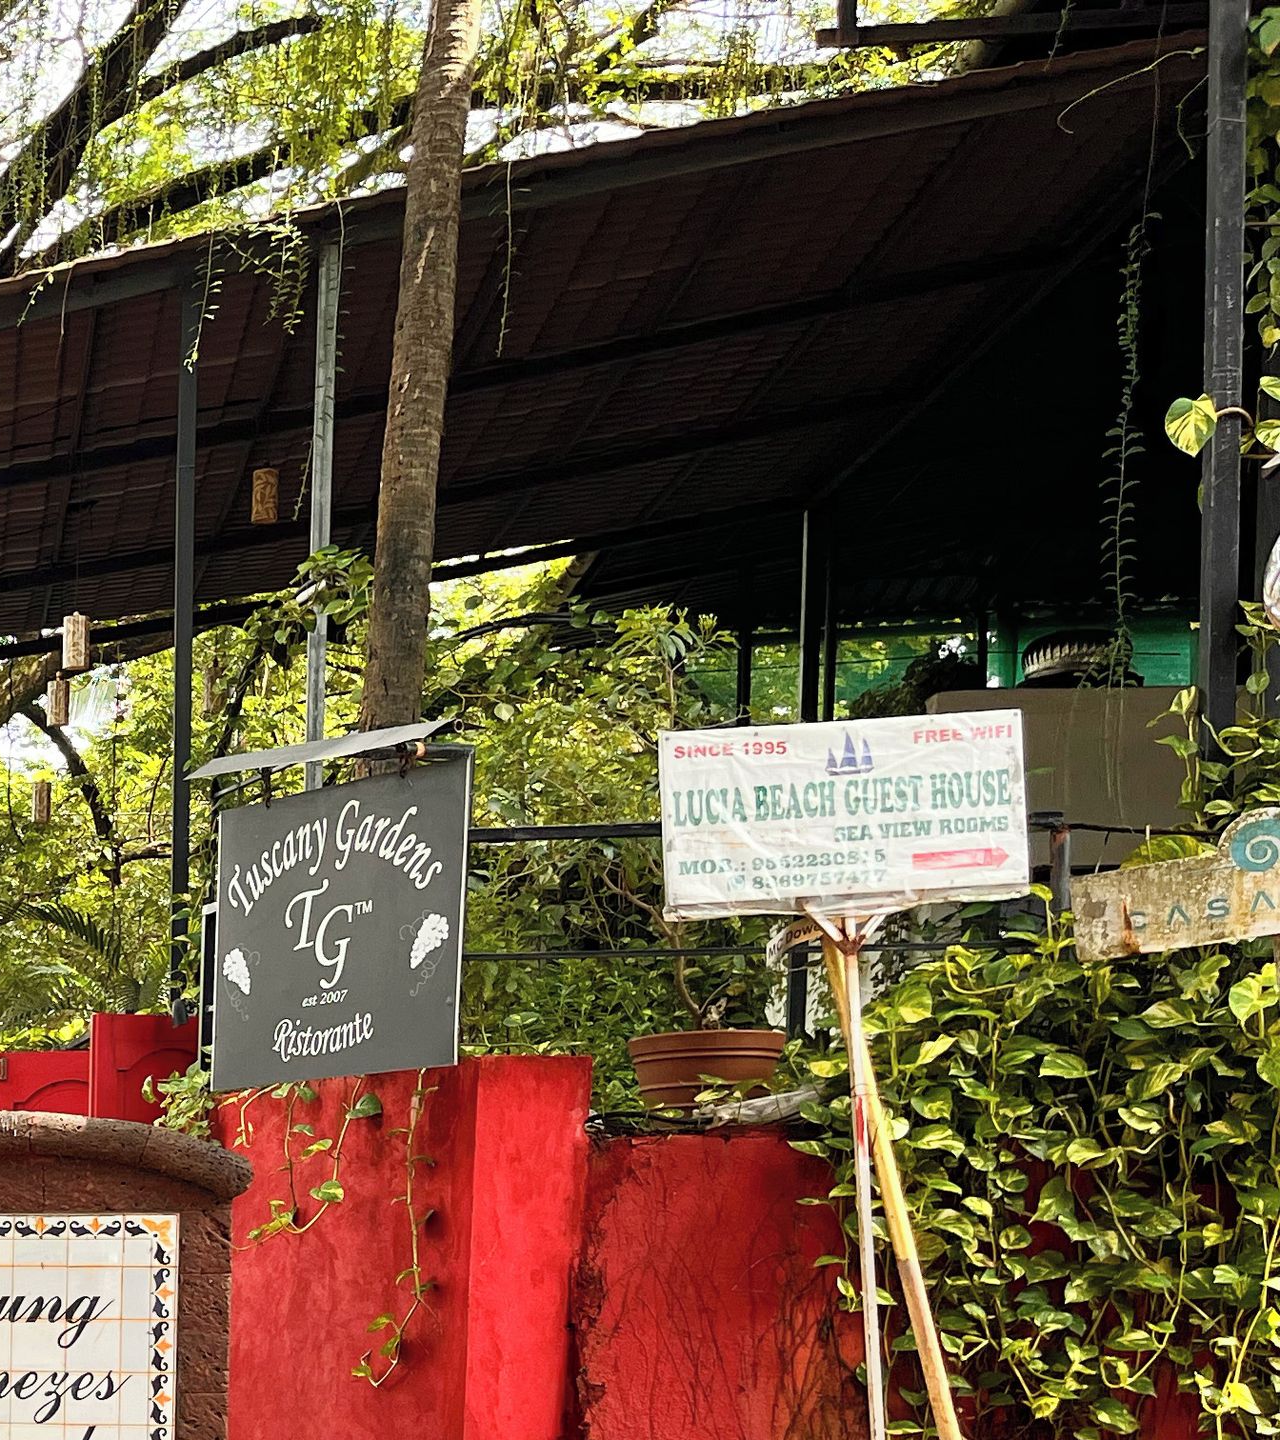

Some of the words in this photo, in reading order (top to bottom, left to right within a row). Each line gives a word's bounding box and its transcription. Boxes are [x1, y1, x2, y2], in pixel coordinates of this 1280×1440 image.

[913, 729, 964, 744] FREE
[970, 724, 1012, 740] WIFI
[674, 744, 734, 759] SINCE
[743, 741, 787, 756] 1995
[672, 786, 748, 827] LUCIA
[753, 780, 836, 822] BEACH
[844, 775, 923, 816] GUEST
[930, 768, 1012, 810] HOUSE
[833, 825, 873, 842] SEA
[878, 819, 932, 840] VIEW
[939, 815, 1009, 836] ROOMS
[228, 816, 328, 918] Tuscany
[335, 799, 444, 890] Gardens
[301, 992, 318, 1008] est
[319, 989, 349, 1006] 2007
[272, 1012, 375, 1063] Ristorante
